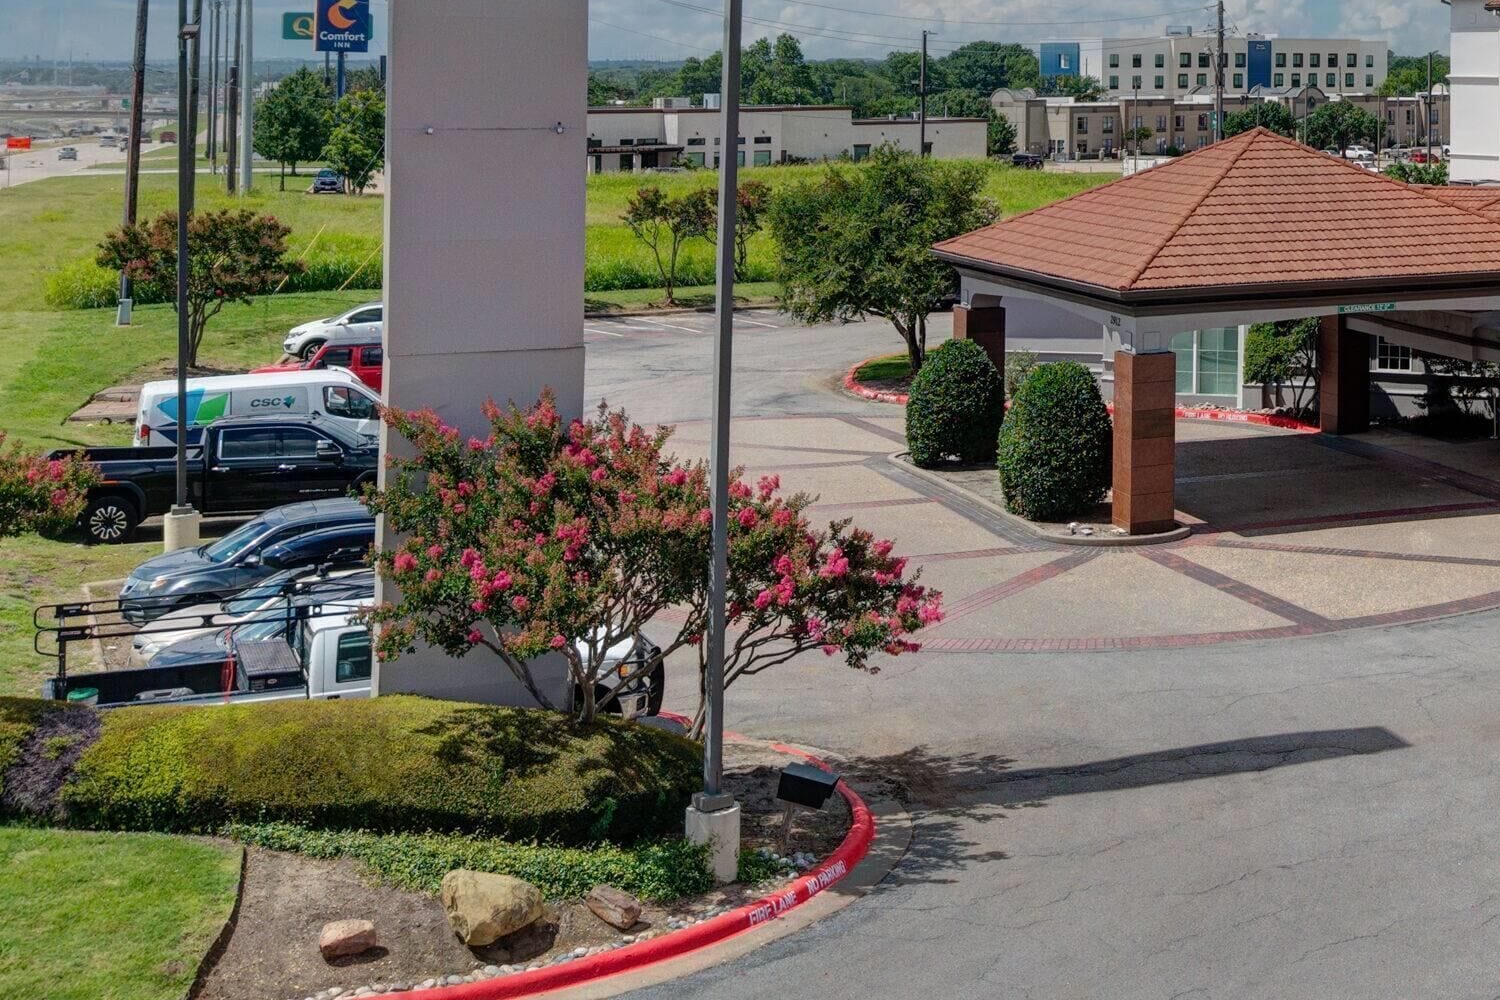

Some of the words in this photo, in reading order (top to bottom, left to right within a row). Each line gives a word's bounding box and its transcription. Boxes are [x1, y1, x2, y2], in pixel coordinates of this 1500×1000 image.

[319, 31, 365, 41] Comfort
[250, 398, 281, 408] CSC
[749, 902, 772, 926] FIRE
[773, 891, 797, 916] LANE
[805, 879, 819, 895] NO
[818, 860, 846, 889] PARKING
